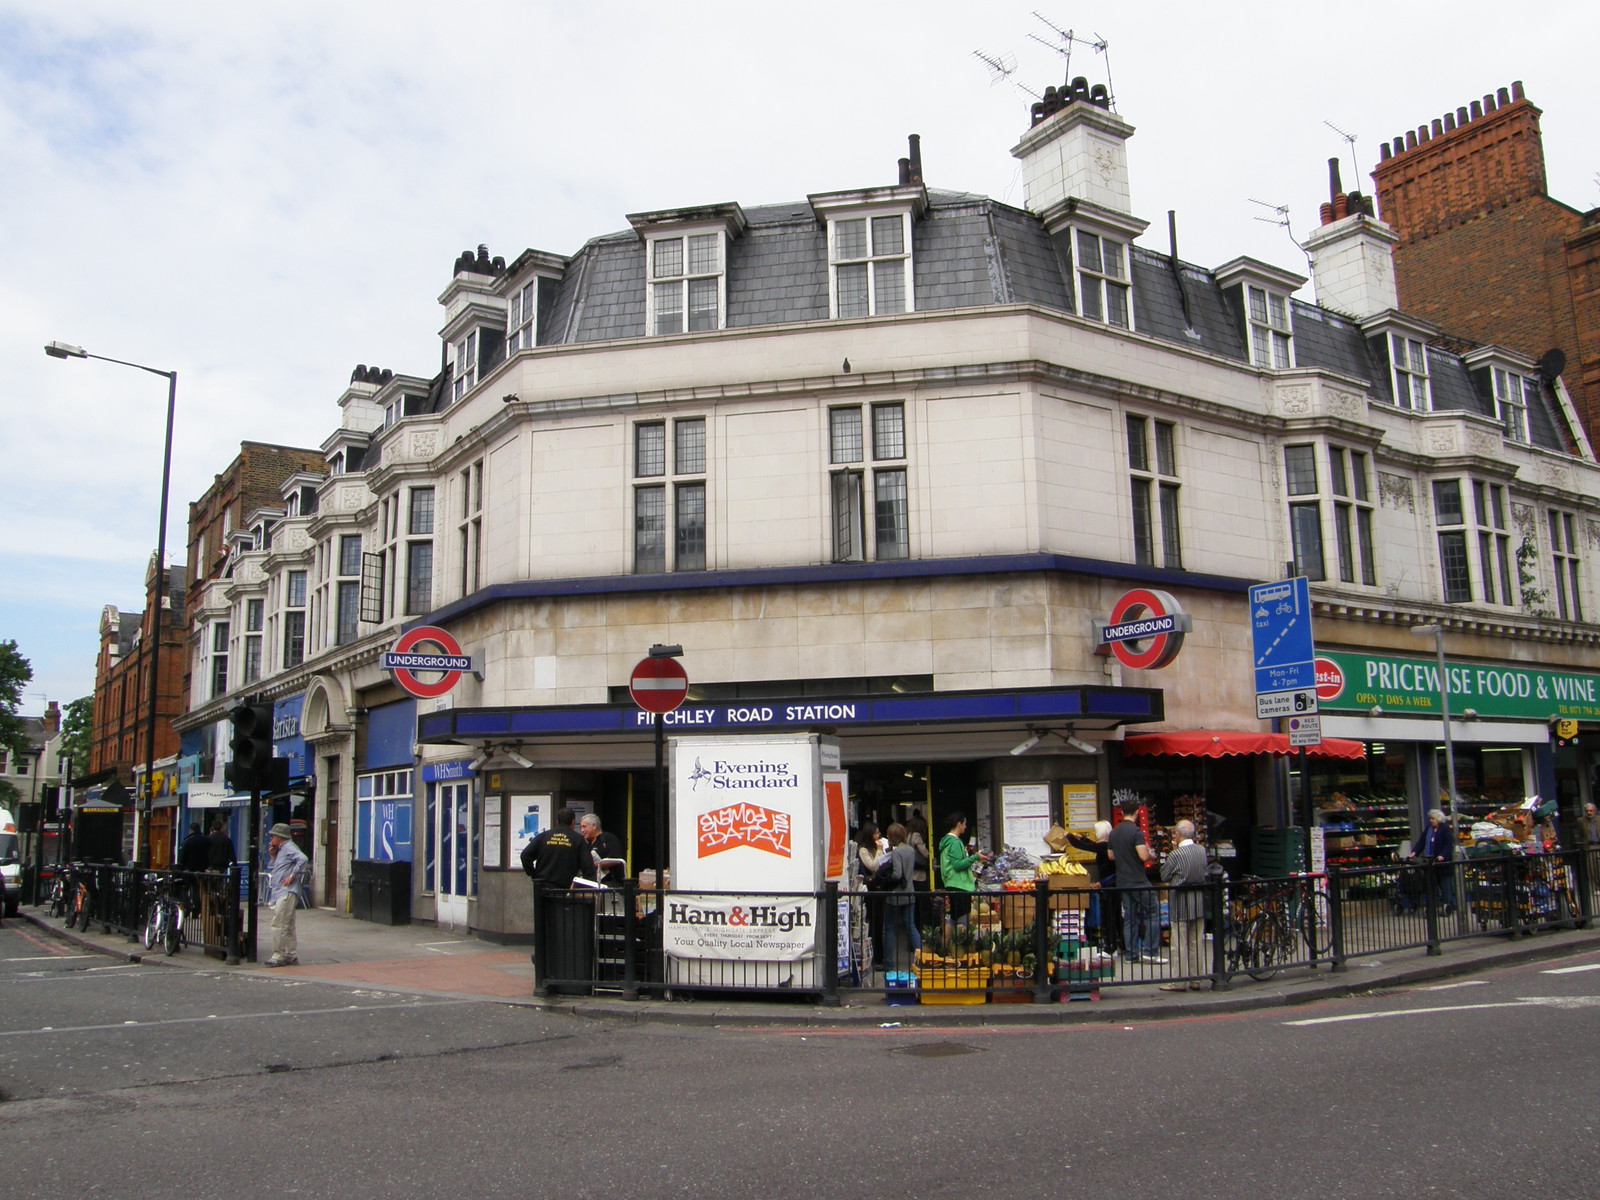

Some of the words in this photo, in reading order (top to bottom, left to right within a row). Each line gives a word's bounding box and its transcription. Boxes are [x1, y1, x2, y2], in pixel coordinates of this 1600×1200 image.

[1105, 619, 1172, 639] UNDERGROUND
[1256, 620, 1269, 628] taxi
[388, 655, 468, 667] UNDERGROUND
[1314, 671, 1341, 683] est-in
[1365, 660, 1471, 695] PRICEWISE
[1476, 669, 1531, 698] FOOD
[1536, 675, 1549, 700] &
[1551, 676, 1597, 702] WINE
[1259, 698, 1273, 706] Bus
[1356, 692, 1377, 704] OPEN
[1379, 694, 1384, 704] 7
[1386, 695, 1404, 706] DAYS
[1406, 696, 1411, 706] A
[1412, 697, 1432, 707] WEEK
[727, 707, 773, 722] ROAD
[785, 704, 856, 720] STATION
[1260, 706, 1290, 714] cameras
[434, 763, 463, 779] WHSmith
[713, 760, 789, 776] Evening
[713, 774, 799, 789] Standard
[382, 804, 394, 820] WH
[668, 903, 812, 932] Ham&High
[674, 937, 694, 946] Your
[697, 938, 728, 949] Quality
[730, 940, 753, 948] Local
[756, 940, 805, 950] Newspaper
